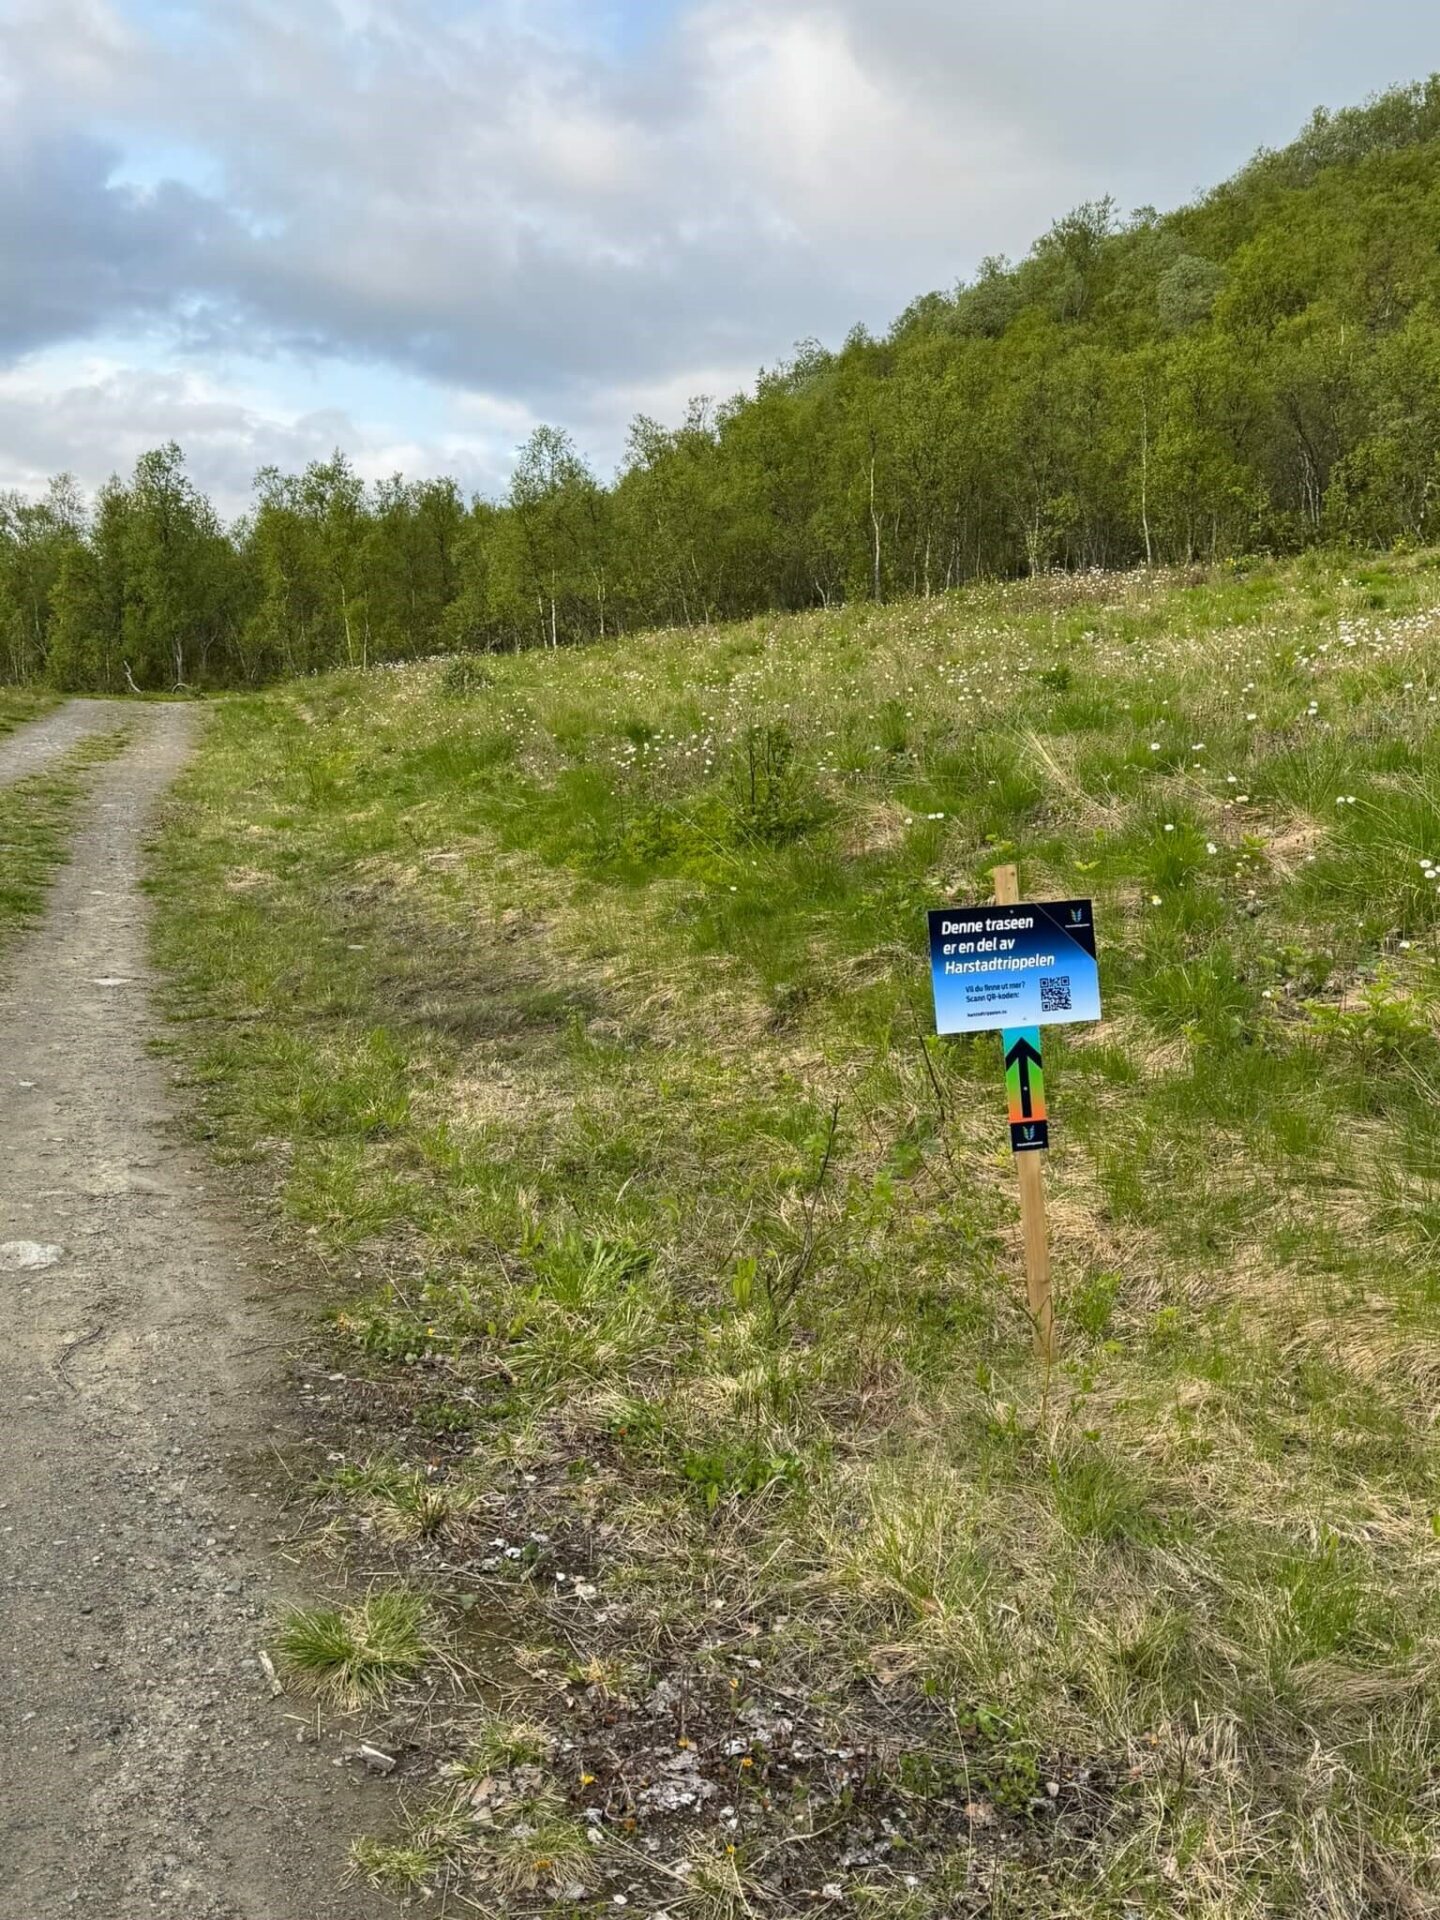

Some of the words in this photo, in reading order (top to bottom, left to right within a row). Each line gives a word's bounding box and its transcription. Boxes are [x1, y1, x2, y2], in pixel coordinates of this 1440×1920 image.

[941, 920, 983, 935] Denne
[985, 917, 1034, 932] traseen
[943, 943, 958, 955] er
[958, 942, 975, 954] en
[977, 938, 997, 952] del
[999, 938, 1015, 950] av
[944, 953, 1055, 975] Harstadtrippelen
[965, 985, 974, 993] Vil
[975, 984, 984, 992] du
[984, 983, 1001, 991] finne
[1009, 981, 1026, 989] mer?
[966, 995, 986, 1003] Scann
